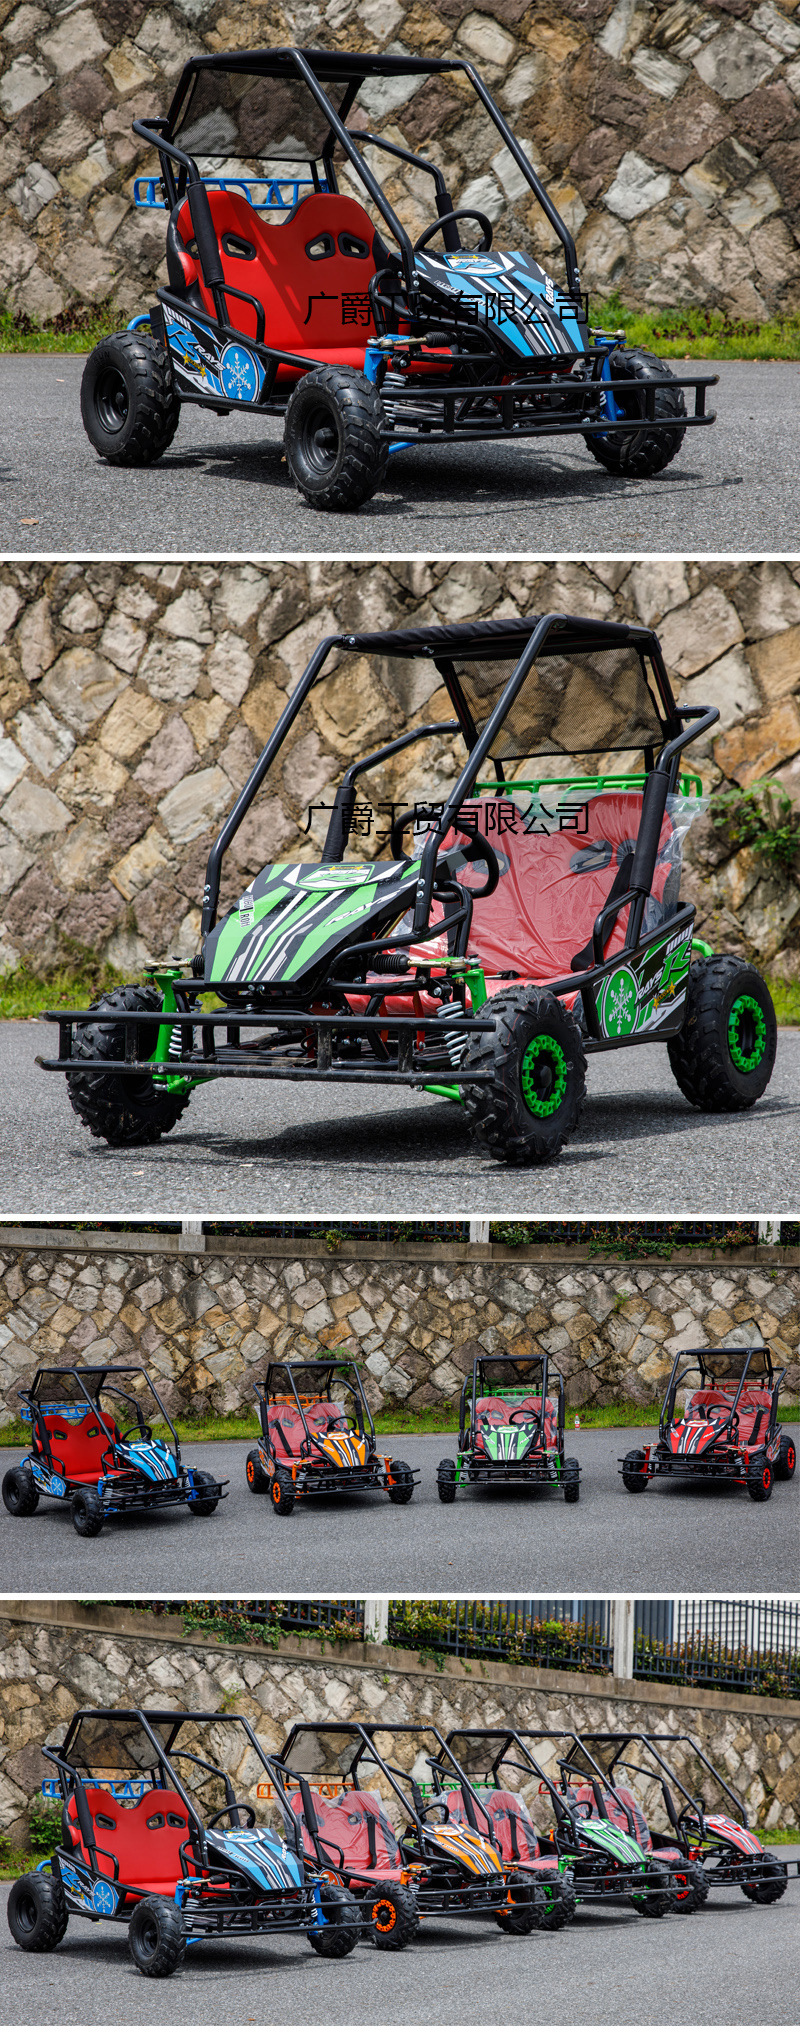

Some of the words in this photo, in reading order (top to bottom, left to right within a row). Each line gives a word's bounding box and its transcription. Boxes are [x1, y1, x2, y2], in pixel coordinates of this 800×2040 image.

[544, 275, 555, 306] RAYS
[193, 344, 227, 371] RAYS
[637, 966, 664, 1000] RAYS
